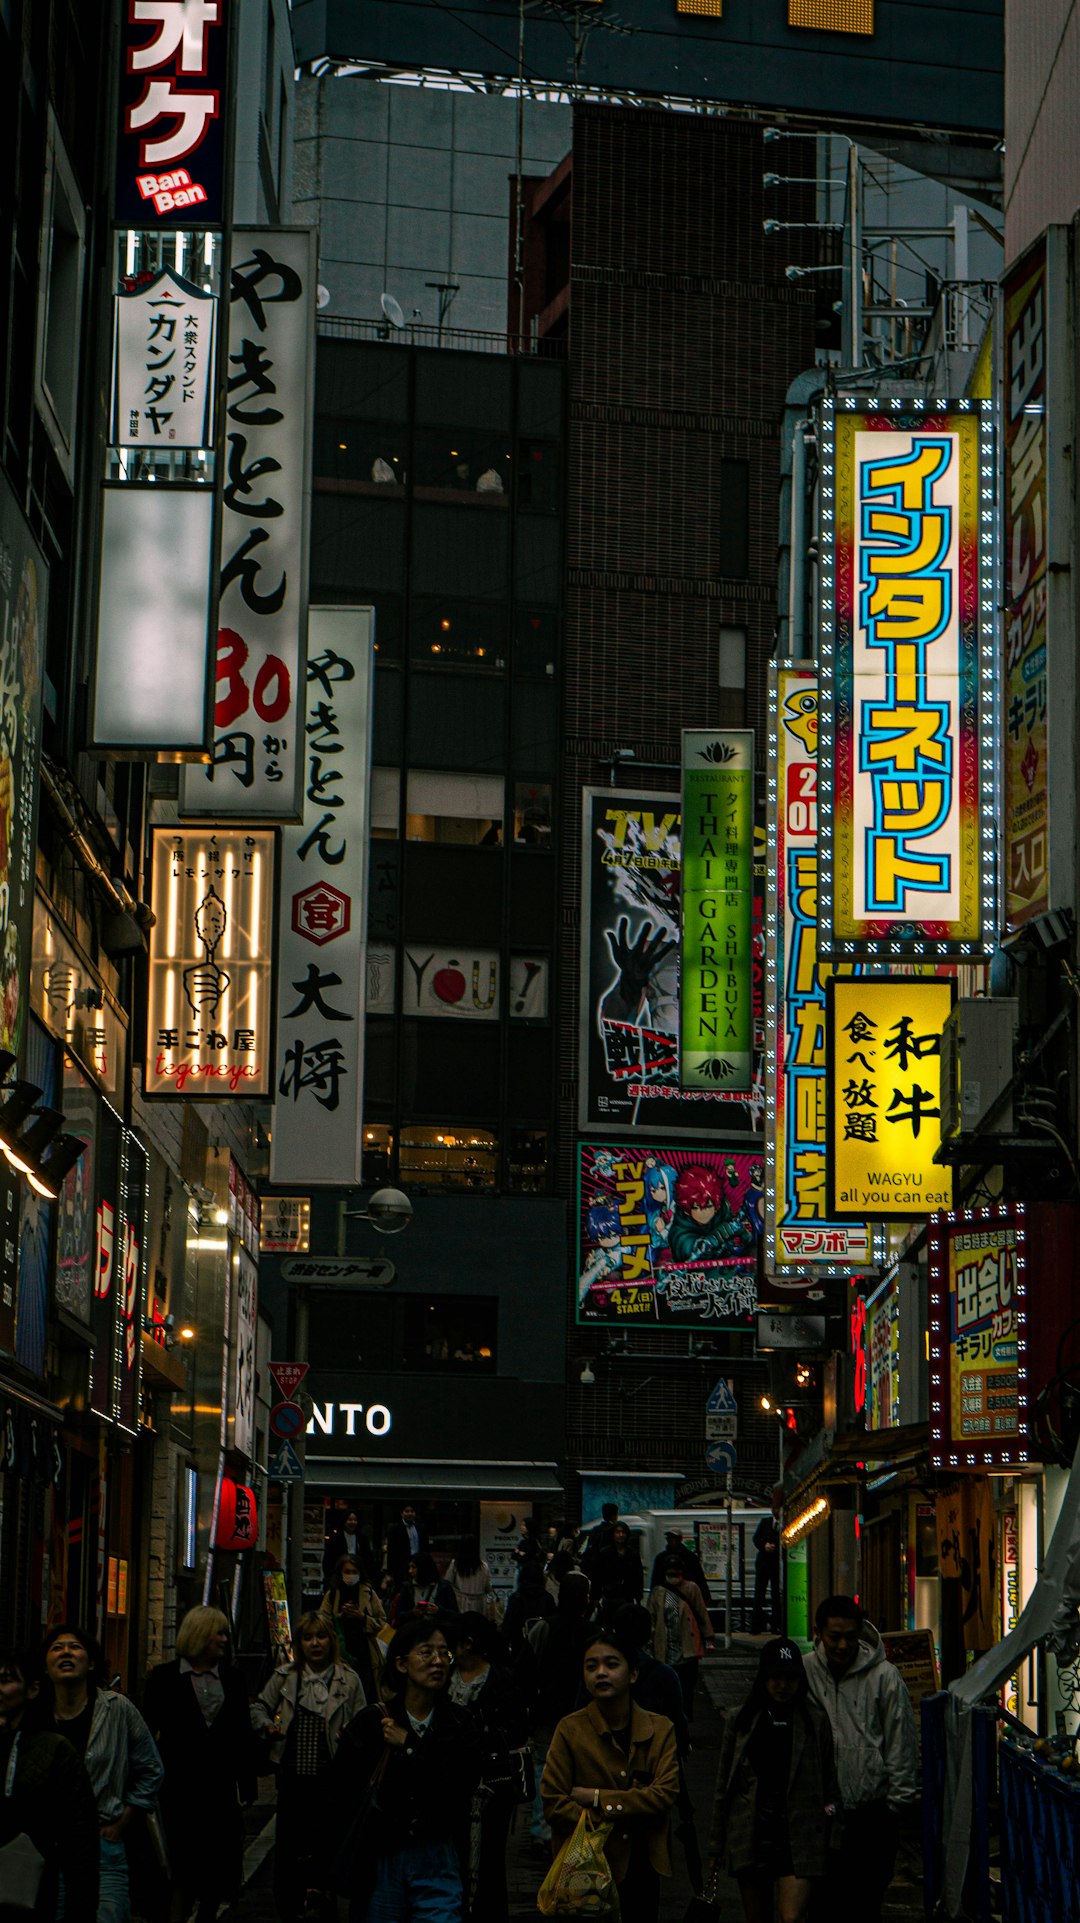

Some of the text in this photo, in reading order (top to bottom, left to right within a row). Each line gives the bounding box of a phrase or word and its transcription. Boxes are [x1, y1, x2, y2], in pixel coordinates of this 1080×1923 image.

[128, 0, 220, 166] オケ
[136, 168, 193, 199] Ban
[152, 184, 208, 214] Ban
[182, 315, 199, 403] 大衆スタンド
[219, 248, 302, 615] やきとん
[864, 442, 948, 907] インターネット
[206, 732, 288, 788] 円 から
[297, 650, 355, 865] やきとん
[690, 774, 747, 784] RESTAURANT
[173, 851, 254, 862] 唐揚げ
[725, 792, 739, 907] タイ料理専門店
[1014, 831, 1045, 890] 入口
[173, 868, 254, 878] レモンサワー
[698, 794, 720, 1036] THAI GARDEN
[725, 925, 739, 1037] SHIBUYA
[157, 1028, 256, 1051] 手ごね屋
[279, 963, 353, 1112] 大将
[155, 1053, 261, 1090] tegoneya
[842, 1011, 880, 1143] 食べ放題
[884, 1016, 942, 1139] 和牛
[840, 1187, 950, 1206] all you can eat
[868, 1172, 922, 1186] WAGYU
[783, 1232, 866, 1252] マンボー
[288, 1263, 386, 1278] 渋谷センター街
[957, 1250, 1018, 1328] 出会い
[956, 1333, 992, 1361] キラリ
[276, 1366, 301, 1376] 止まれ
[280, 1377, 298, 1385] STOP
[305, 1403, 392, 1437] NTO
[779, 1647, 793, 1660] NY
